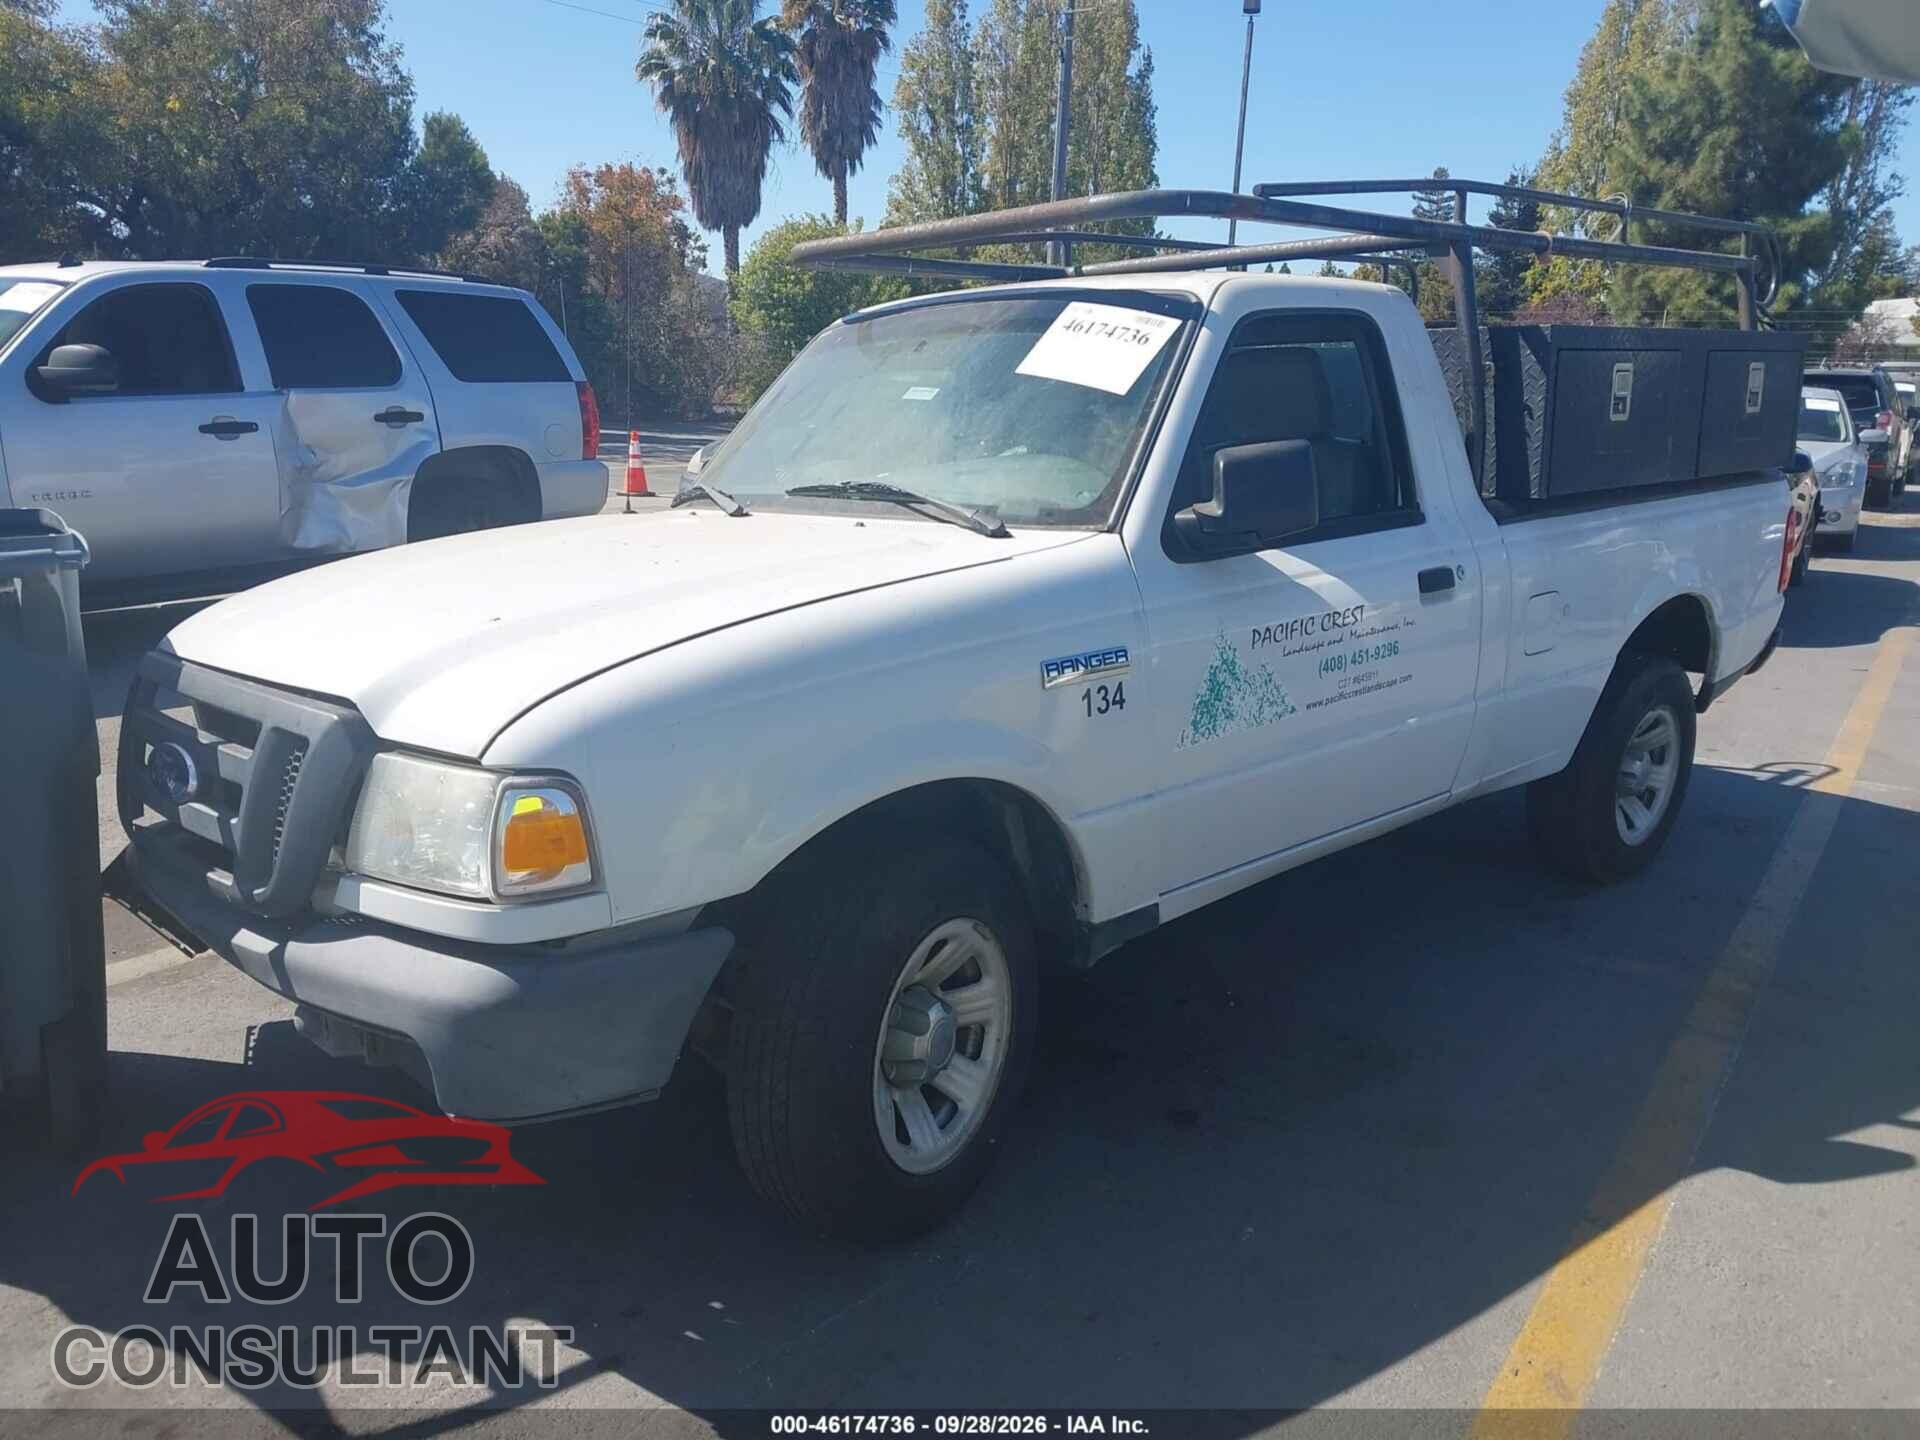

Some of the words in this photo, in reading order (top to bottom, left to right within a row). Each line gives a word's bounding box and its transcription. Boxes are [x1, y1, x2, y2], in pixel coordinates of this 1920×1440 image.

[1063, 318, 1150, 346] 46174736
[1251, 615, 1315, 650] PACIFIC
[1320, 604, 1365, 632] CREST
[1327, 632, 1344, 648] and
[1044, 649, 1129, 678] RANGER
[1319, 653, 1347, 679] (408)
[1350, 640, 1399, 666] 451-9296
[1081, 681, 1126, 717] 134
